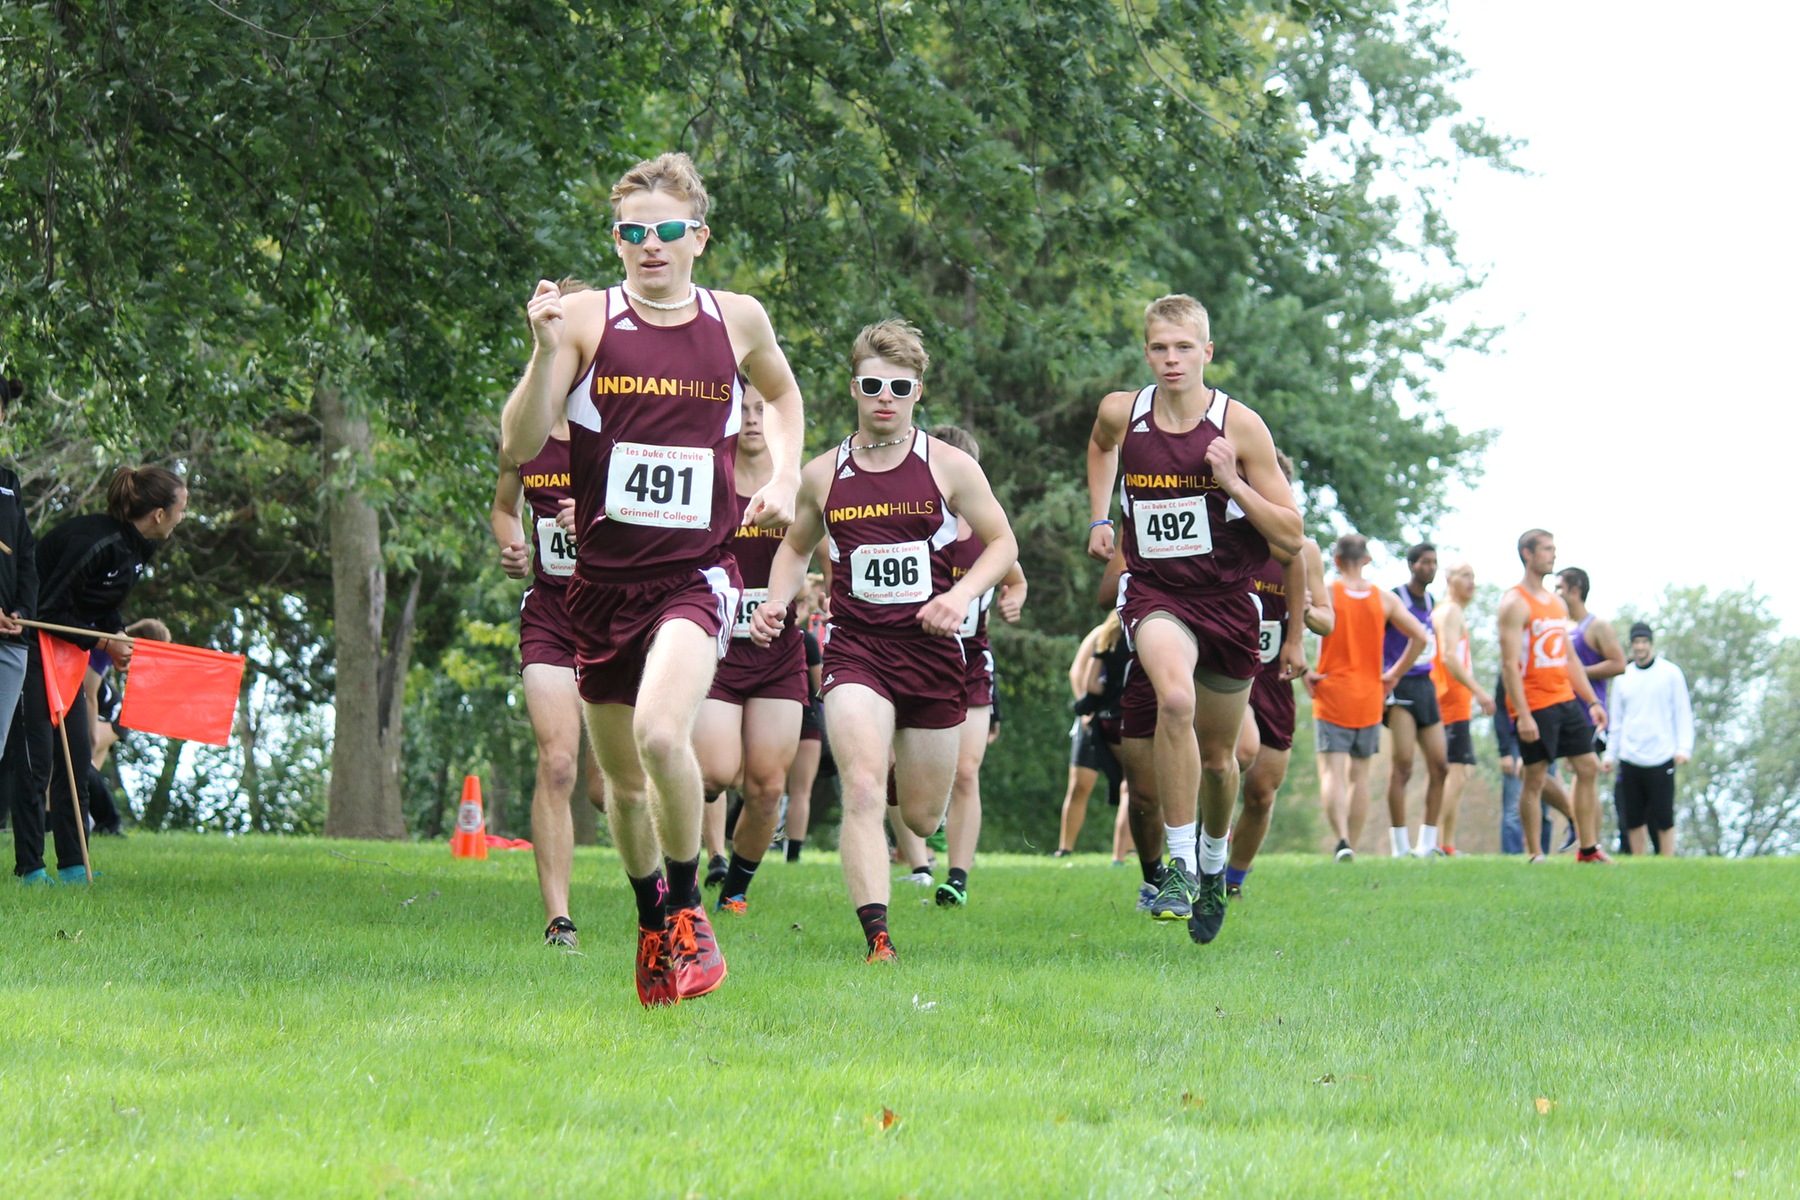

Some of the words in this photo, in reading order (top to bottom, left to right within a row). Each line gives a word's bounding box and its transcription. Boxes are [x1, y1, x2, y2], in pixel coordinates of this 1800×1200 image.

[626, 447, 639, 456] Les
[642, 449, 664, 458] Duke
[667, 451, 677, 459] CC
[680, 452, 704, 461] Invite
[625, 463, 693, 505] 491
[620, 507, 660, 519] Grinnell
[663, 511, 698, 523] College
[1147, 511, 1198, 541] 492
[1148, 545, 1174, 553] Grinnell
[1176, 543, 1202, 552] College
[865, 556, 918, 587] 496
[895, 590, 922, 598] College
[736, 600, 767, 624] 49
